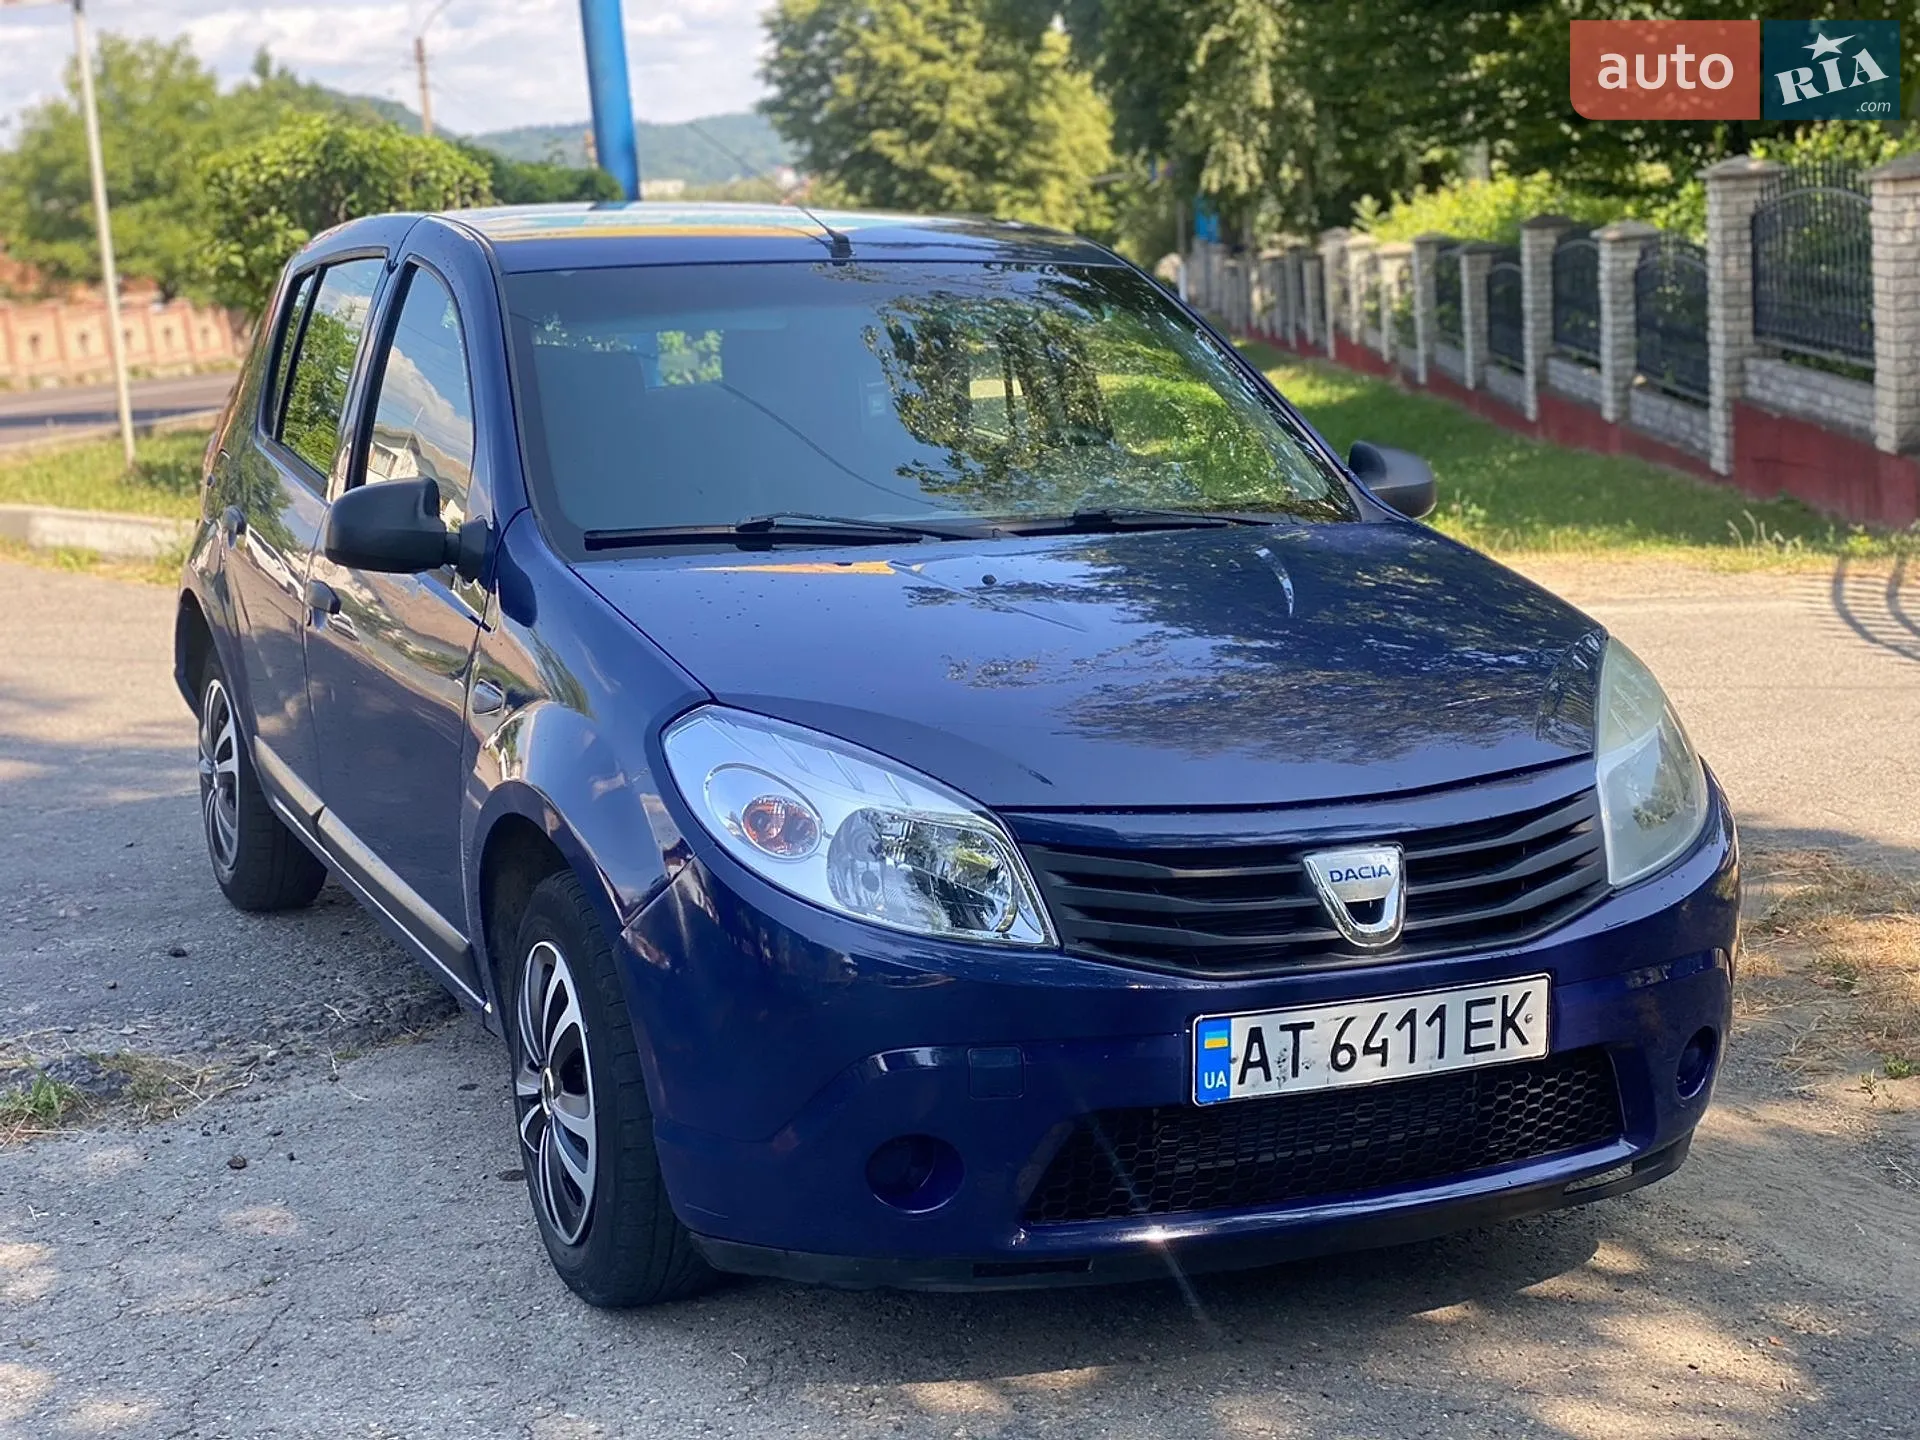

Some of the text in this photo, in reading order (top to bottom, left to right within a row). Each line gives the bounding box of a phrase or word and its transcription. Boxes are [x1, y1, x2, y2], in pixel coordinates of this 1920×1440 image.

[1329, 864, 1391, 883] DACIA
[1237, 990, 1532, 1085] AT 6411 EK
[1204, 1070, 1227, 1090] UA
